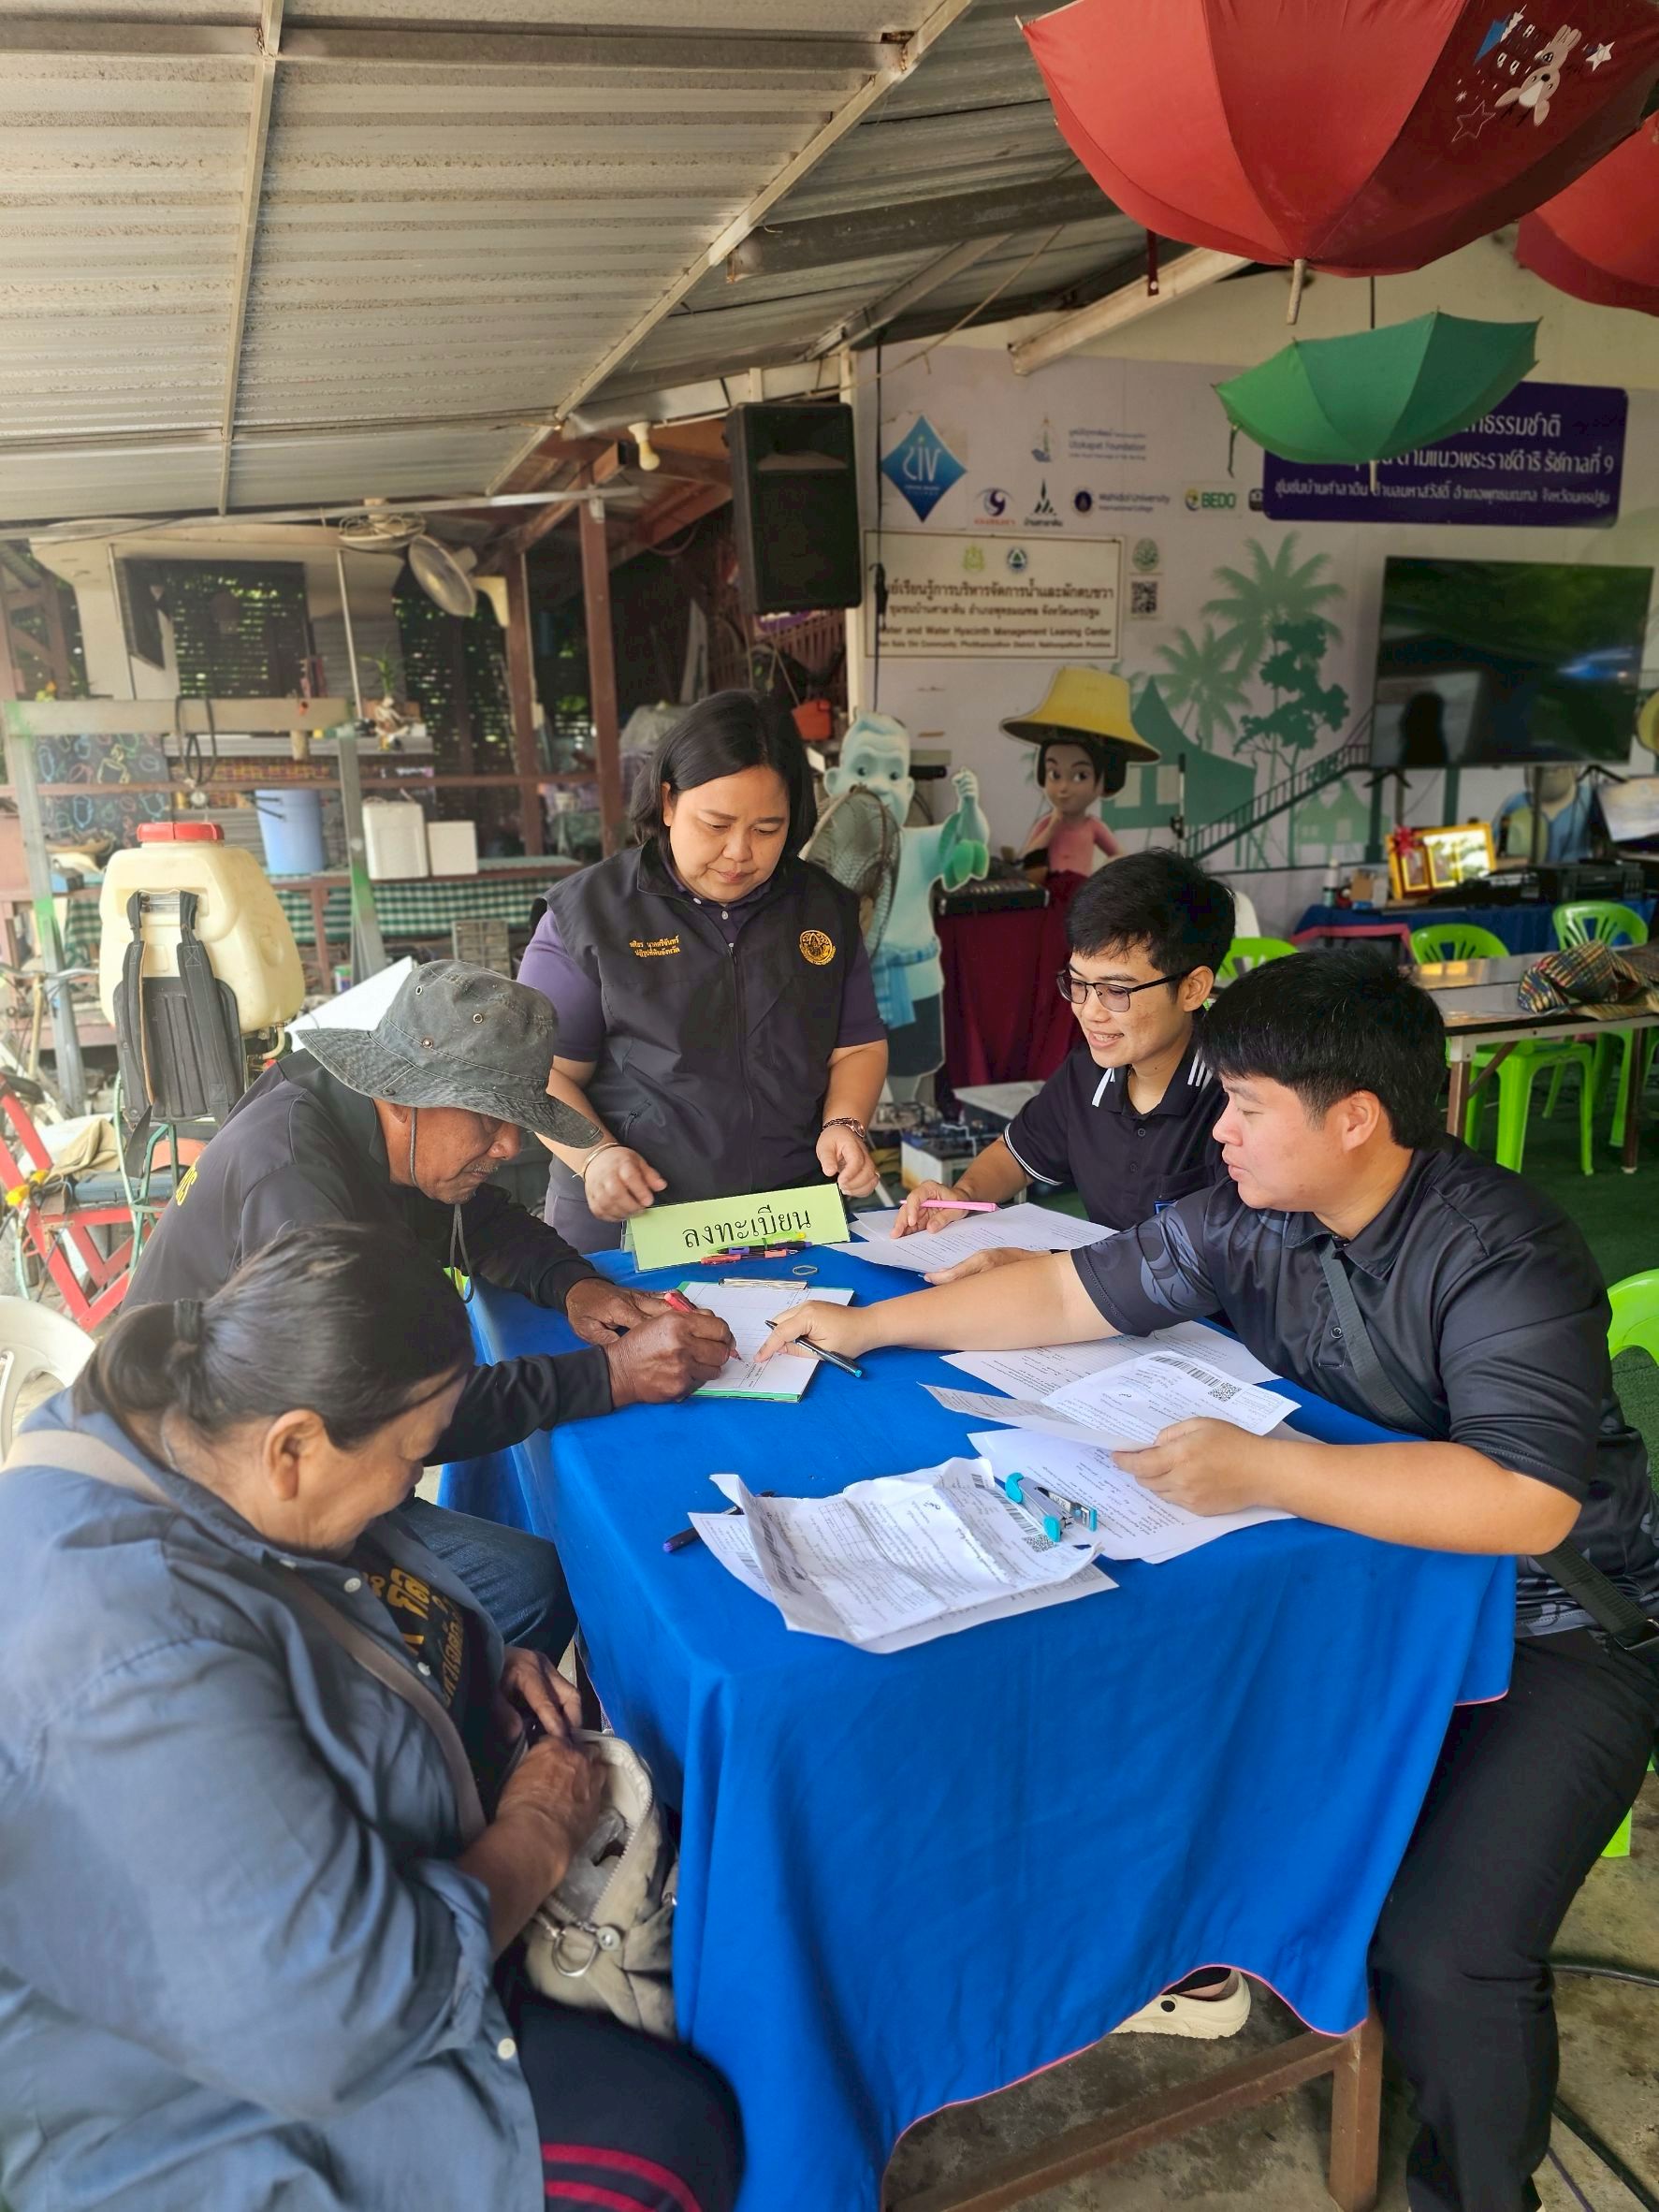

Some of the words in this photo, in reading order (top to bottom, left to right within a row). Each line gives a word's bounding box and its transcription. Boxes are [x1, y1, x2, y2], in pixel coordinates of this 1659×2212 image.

[1604, 455, 1614, 475] 9
[1201, 492, 1236, 508] BEDO
[885, 577, 1114, 601] ย์เรียนรู้การบริหารจัดการน้ำและผักตบชวา
[880, 626, 902, 635] ater
[682, 1203, 811, 1248] ลงทะเบียน
